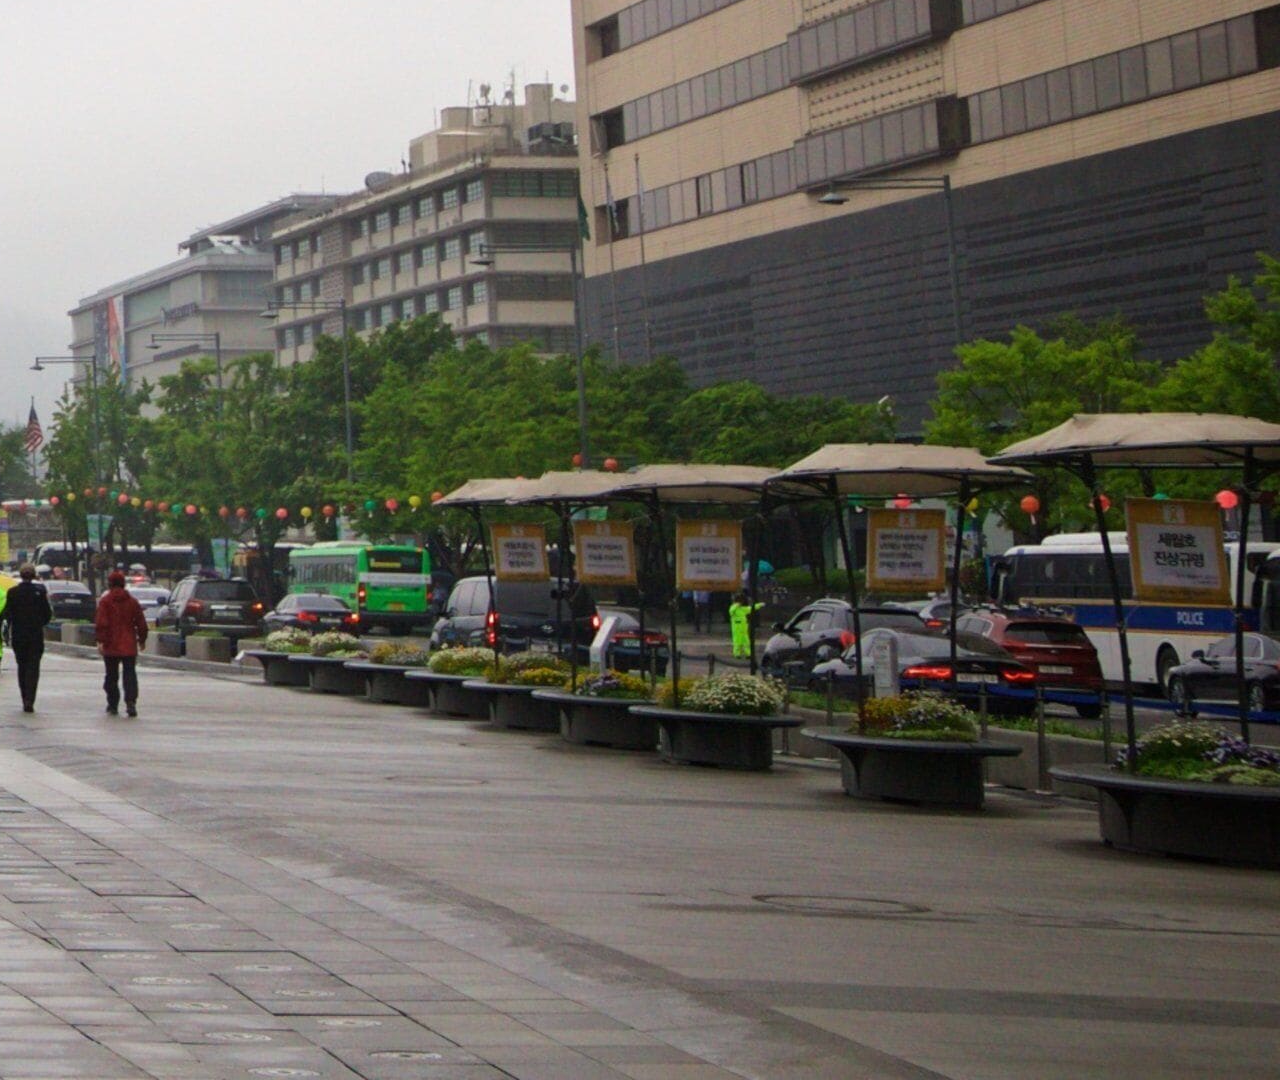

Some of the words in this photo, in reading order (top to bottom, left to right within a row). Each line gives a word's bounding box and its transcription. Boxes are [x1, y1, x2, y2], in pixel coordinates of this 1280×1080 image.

[1157, 532, 1197, 548] 세월호
[1154, 551, 1205, 568] 진상규명
[1176, 611, 1204, 626] POLICE
